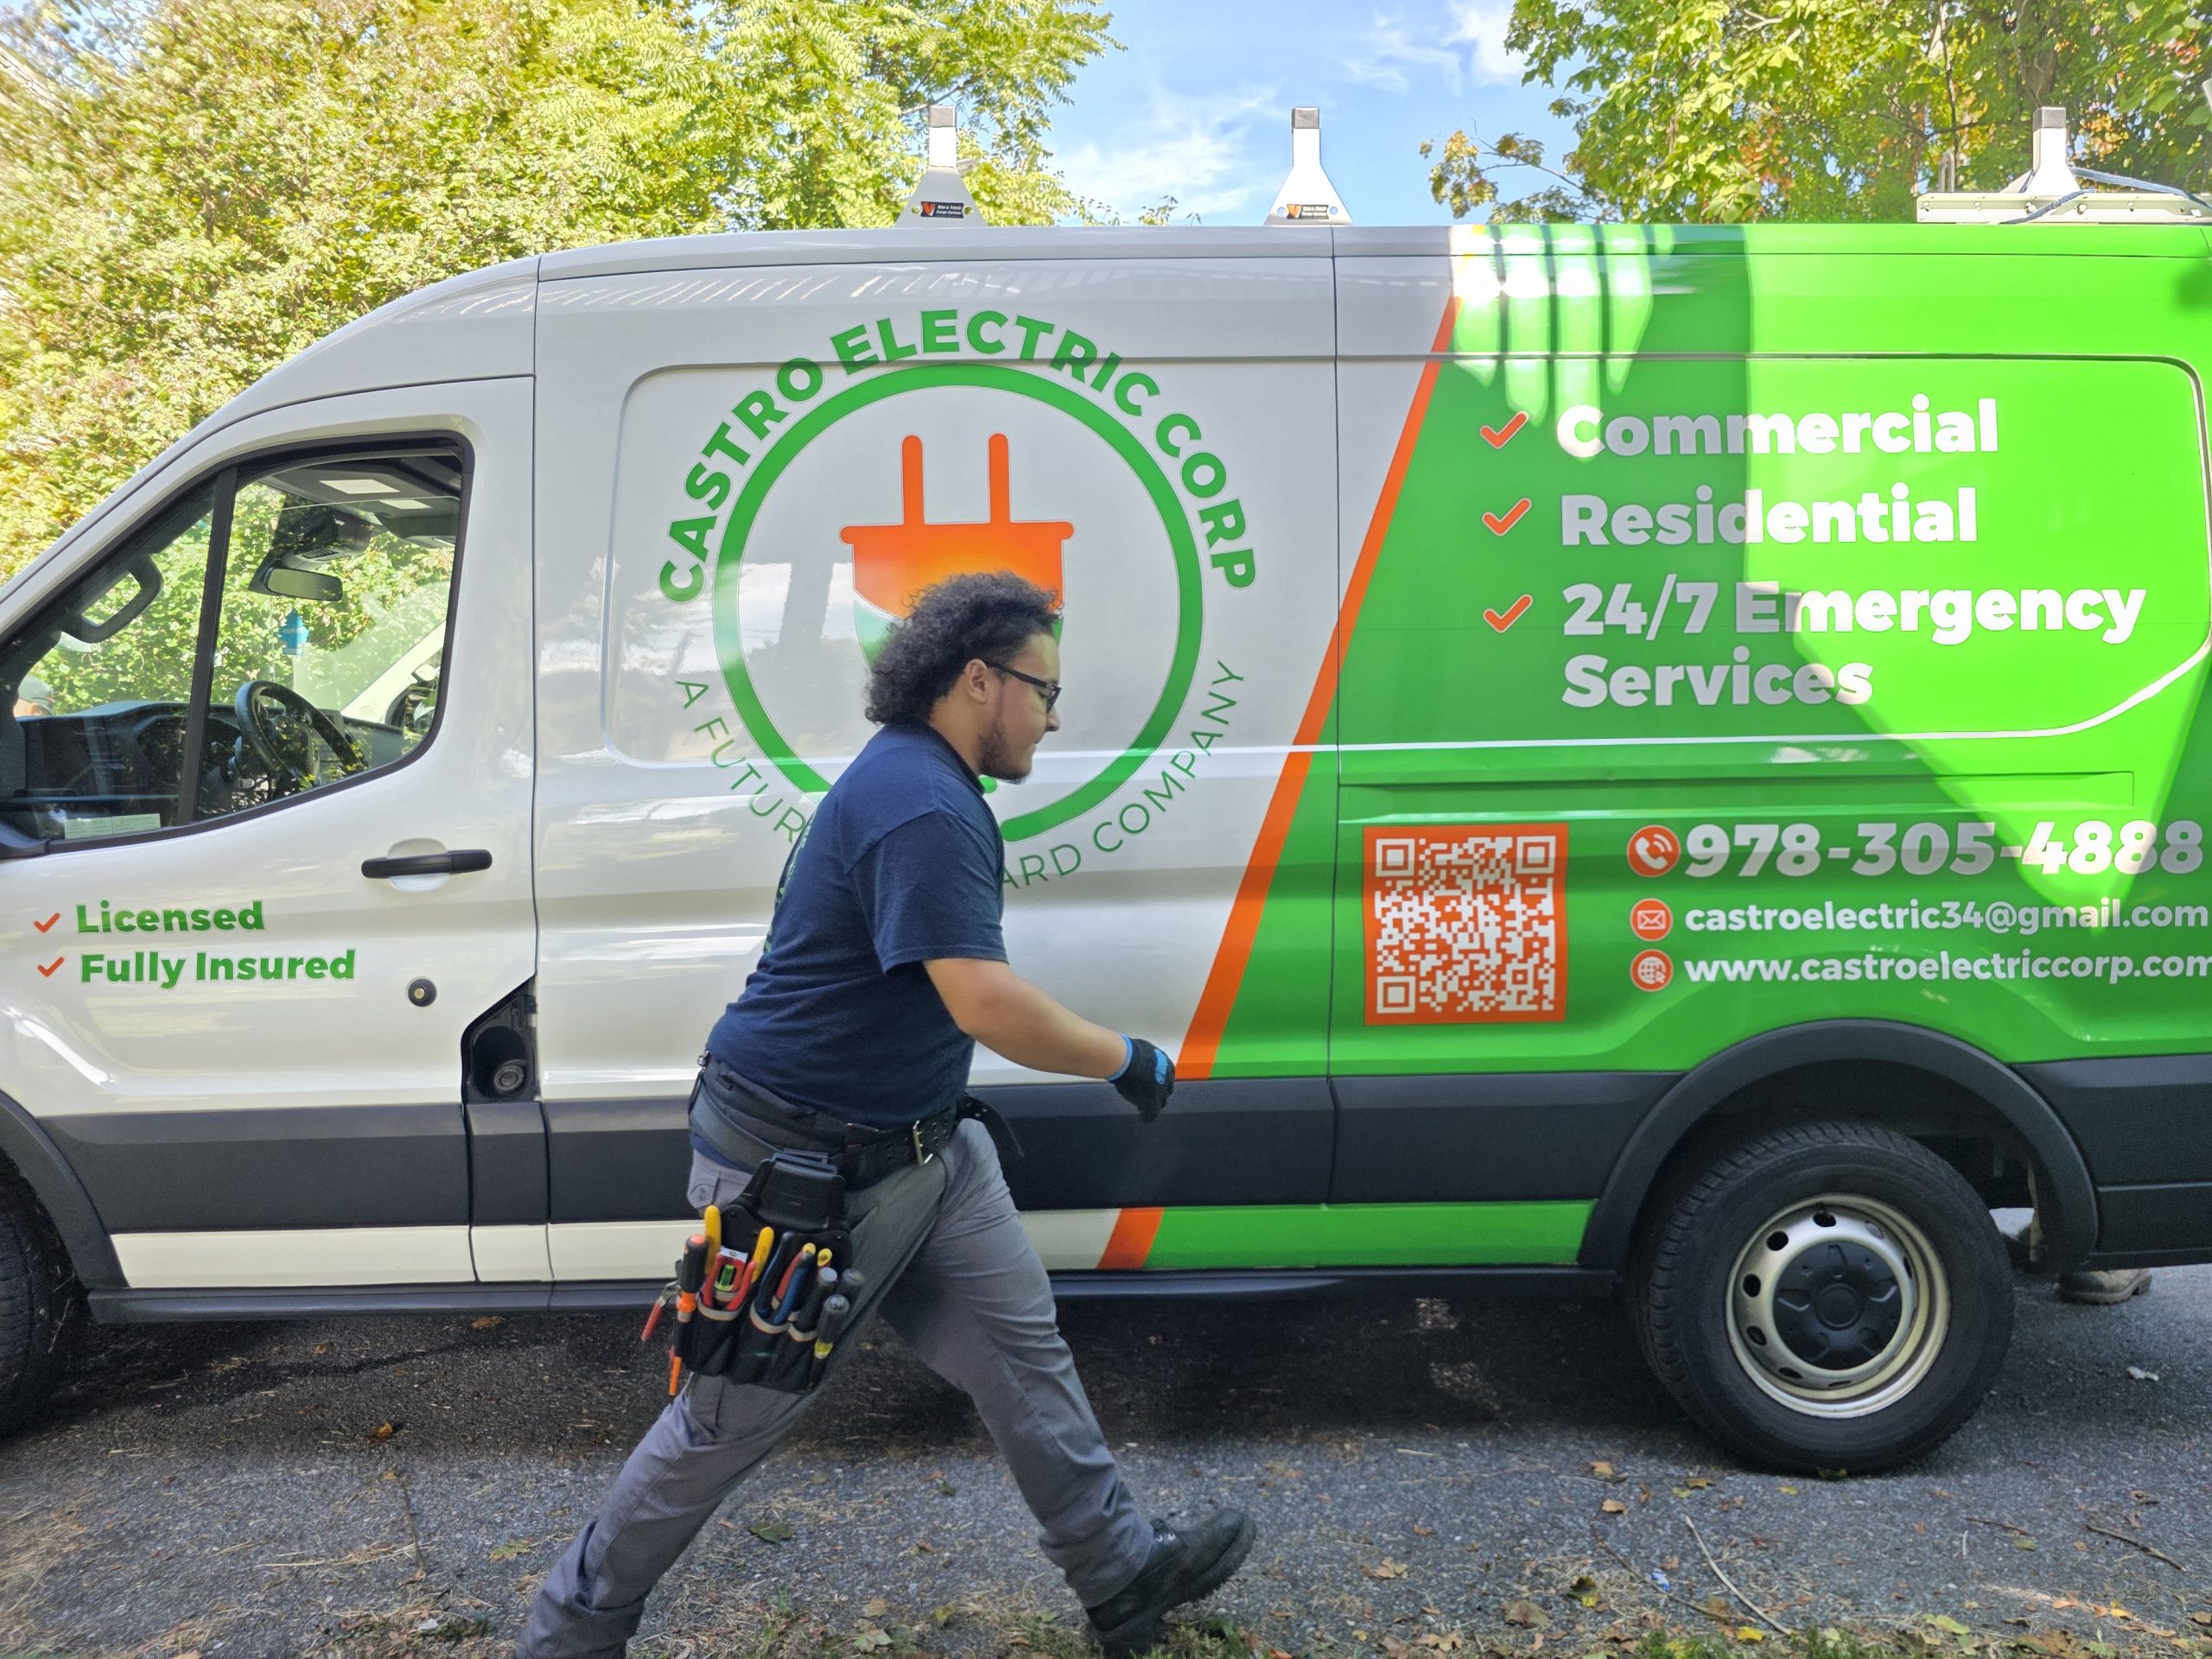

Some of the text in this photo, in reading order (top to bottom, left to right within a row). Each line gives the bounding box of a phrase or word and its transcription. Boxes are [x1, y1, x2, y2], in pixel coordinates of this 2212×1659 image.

[658, 309, 1257, 602] CASTRO ELECTRIC CORP
[1556, 394, 1999, 458] Commercial
[1561, 481, 1978, 546] Residential
[1562, 574, 2148, 645] 24/7 Emergency
[1561, 645, 1873, 709] Services
[676, 680, 709, 709] A
[693, 716, 806, 843] FUTUR
[1093, 659, 1244, 853] COMPANY
[1685, 820, 2203, 878] 978-305-4888
[76, 899, 265, 934] Licensed
[1684, 896, 2209, 936] castroelectric34@gmail.com
[81, 949, 356, 989] Fully Insured
[1684, 950, 2212, 984] www.castroelectriccorp.com
